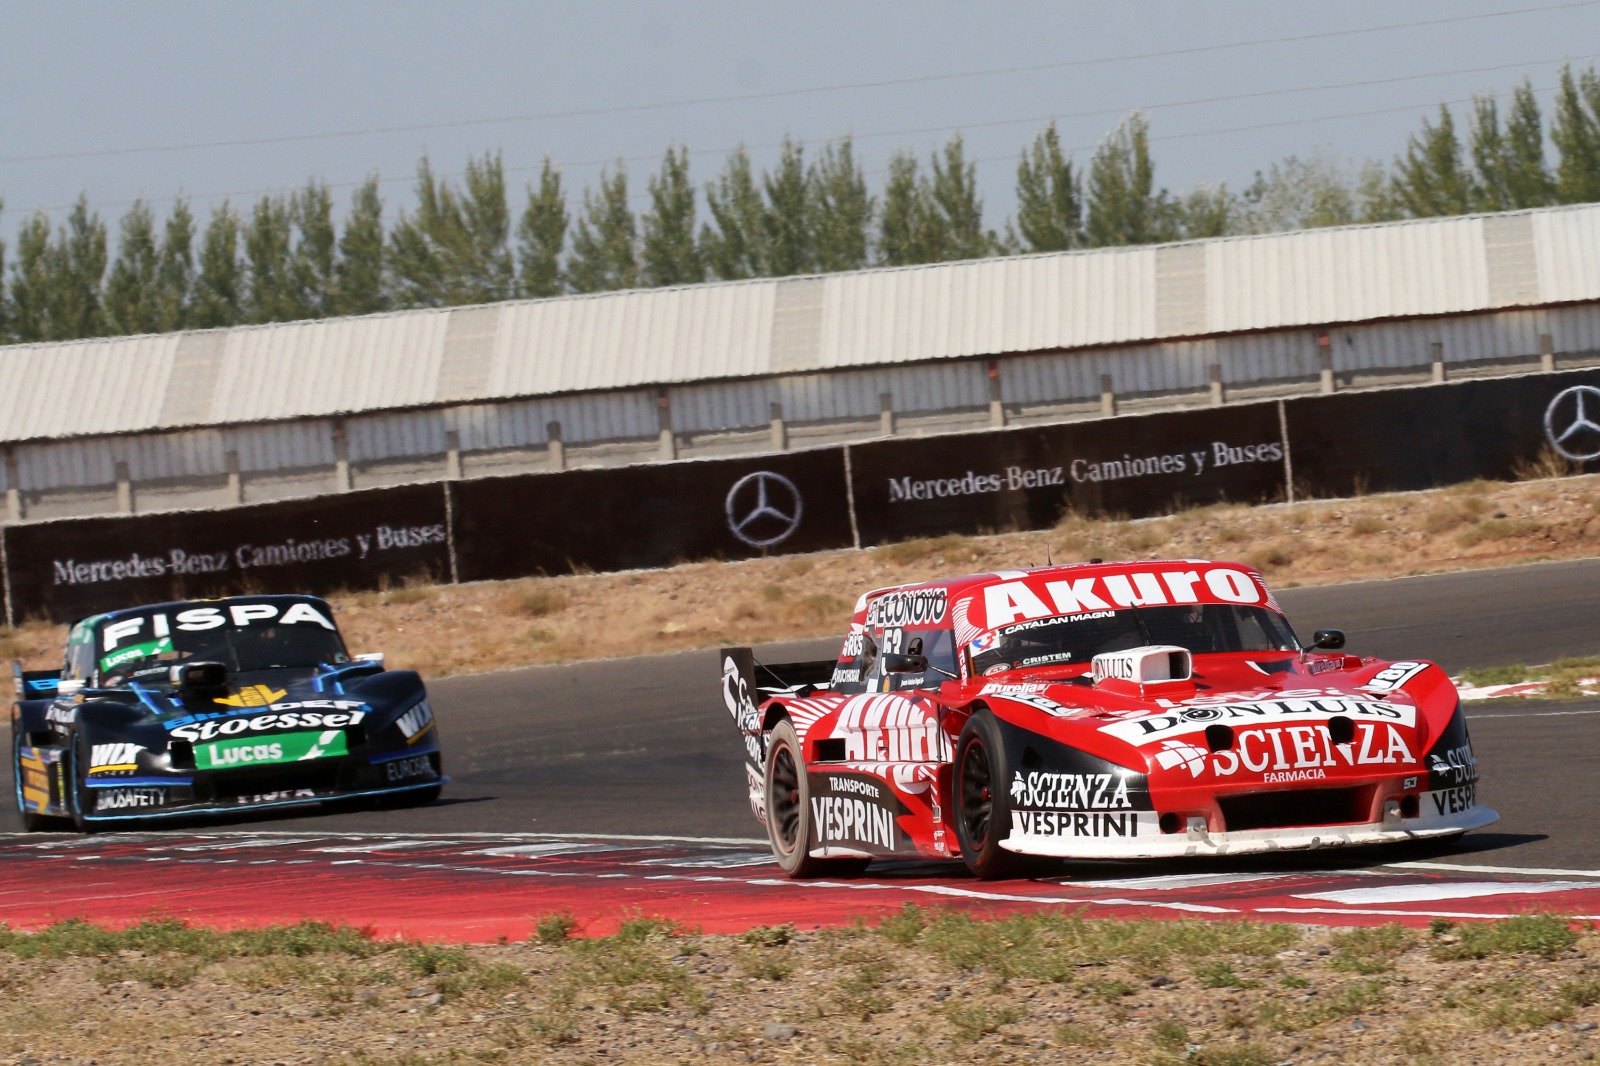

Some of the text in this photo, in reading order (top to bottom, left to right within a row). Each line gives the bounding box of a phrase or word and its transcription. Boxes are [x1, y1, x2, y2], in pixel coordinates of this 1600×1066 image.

[887, 441, 1283, 503] Mercedes-Benz Camiones y Buses
[53, 523, 446, 585] Mercedes-Benz Camiones y Buses
[103, 602, 337, 652] FISPA
[1004, 615, 1069, 635] CATALAN
[1070, 610, 1116, 623] MAGNI
[1022, 651, 1072, 665] CRISTEM
[1282, 698, 1402, 719] LUIS
[170, 710, 366, 744] Stoessel
[91, 743, 147, 768] WIX
[209, 742, 283, 767] Lucas
[1211, 723, 1416, 777] SCIENZA
[829, 776, 880, 799] TRANSPORTE
[1264, 769, 1326, 783] FARMACIA
[1023, 771, 1132, 810] SCIENZA
[811, 796, 895, 852] VESPRINI
[1019, 811, 1138, 838] VESPRINI
